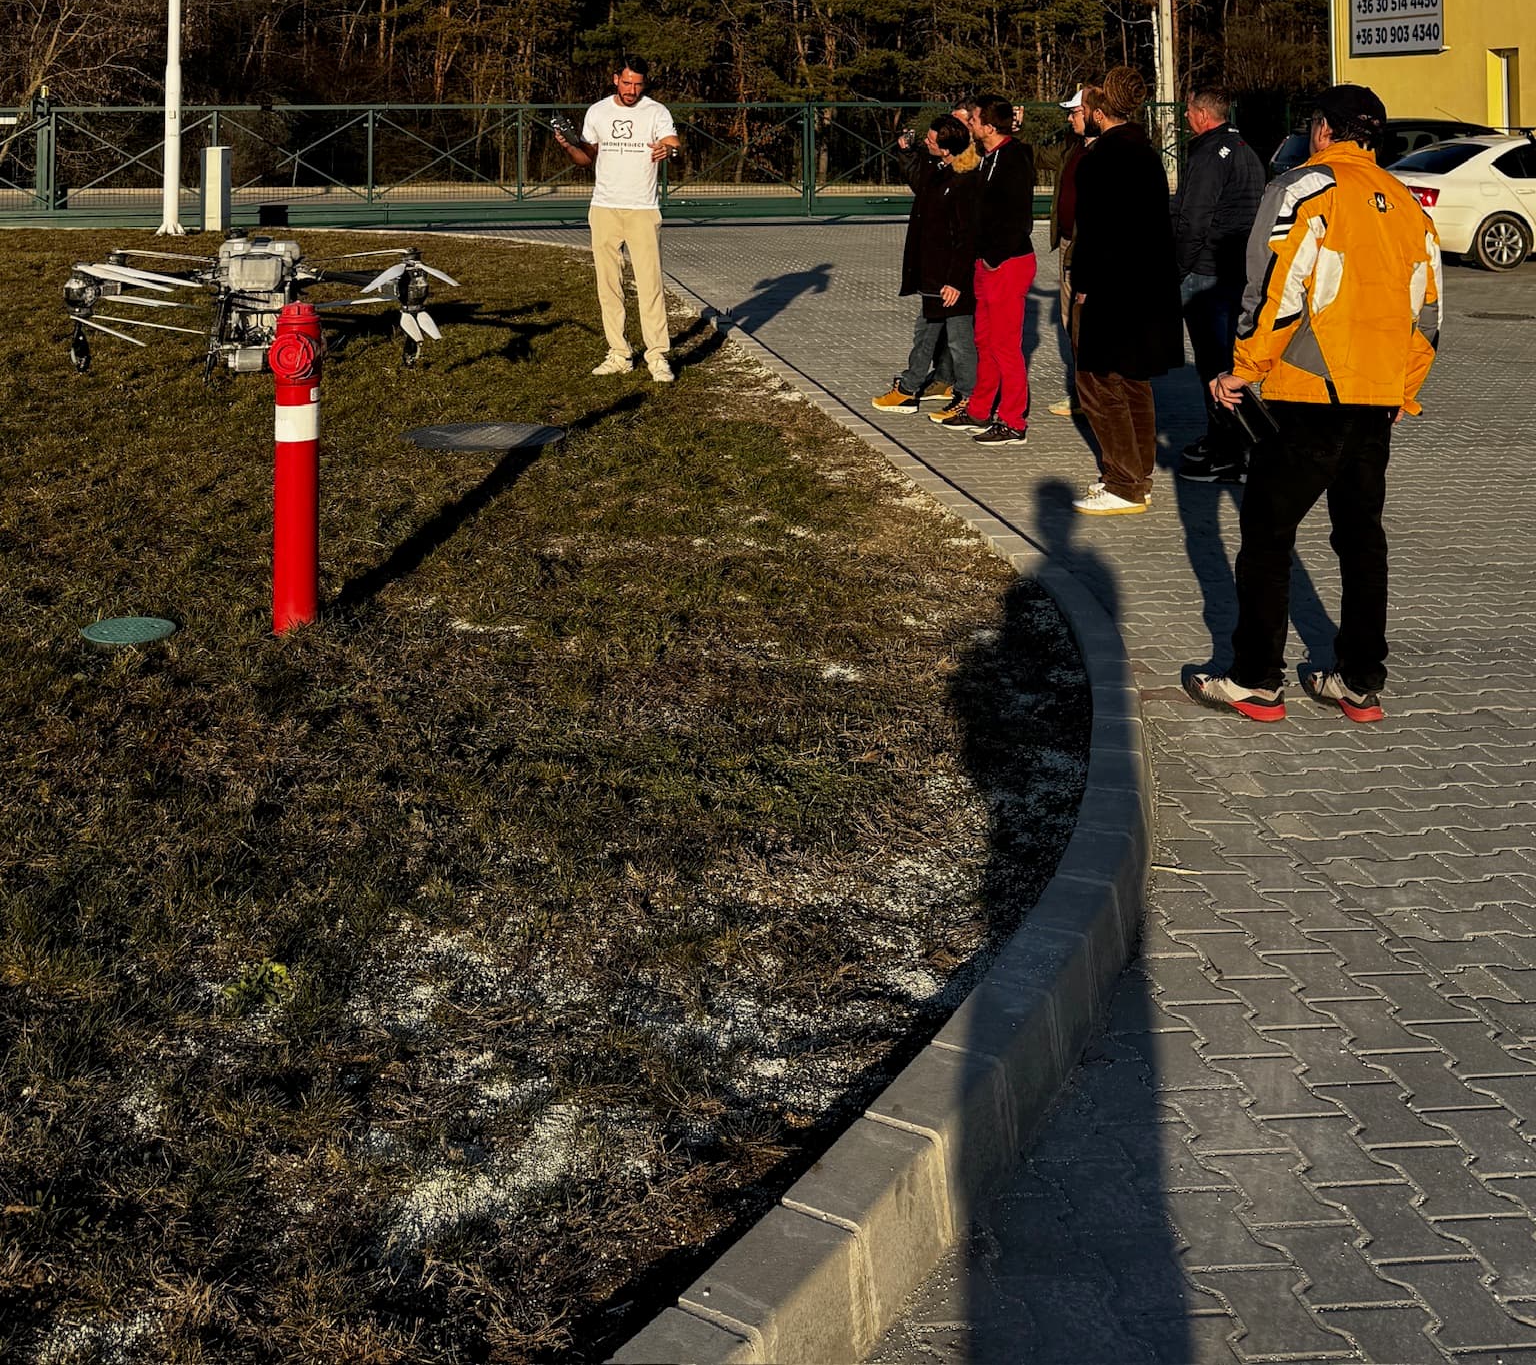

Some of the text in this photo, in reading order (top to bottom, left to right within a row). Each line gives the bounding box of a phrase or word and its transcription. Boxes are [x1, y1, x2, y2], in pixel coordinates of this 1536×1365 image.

[1356, 23, 1440, 45] +36 30 903 4340
